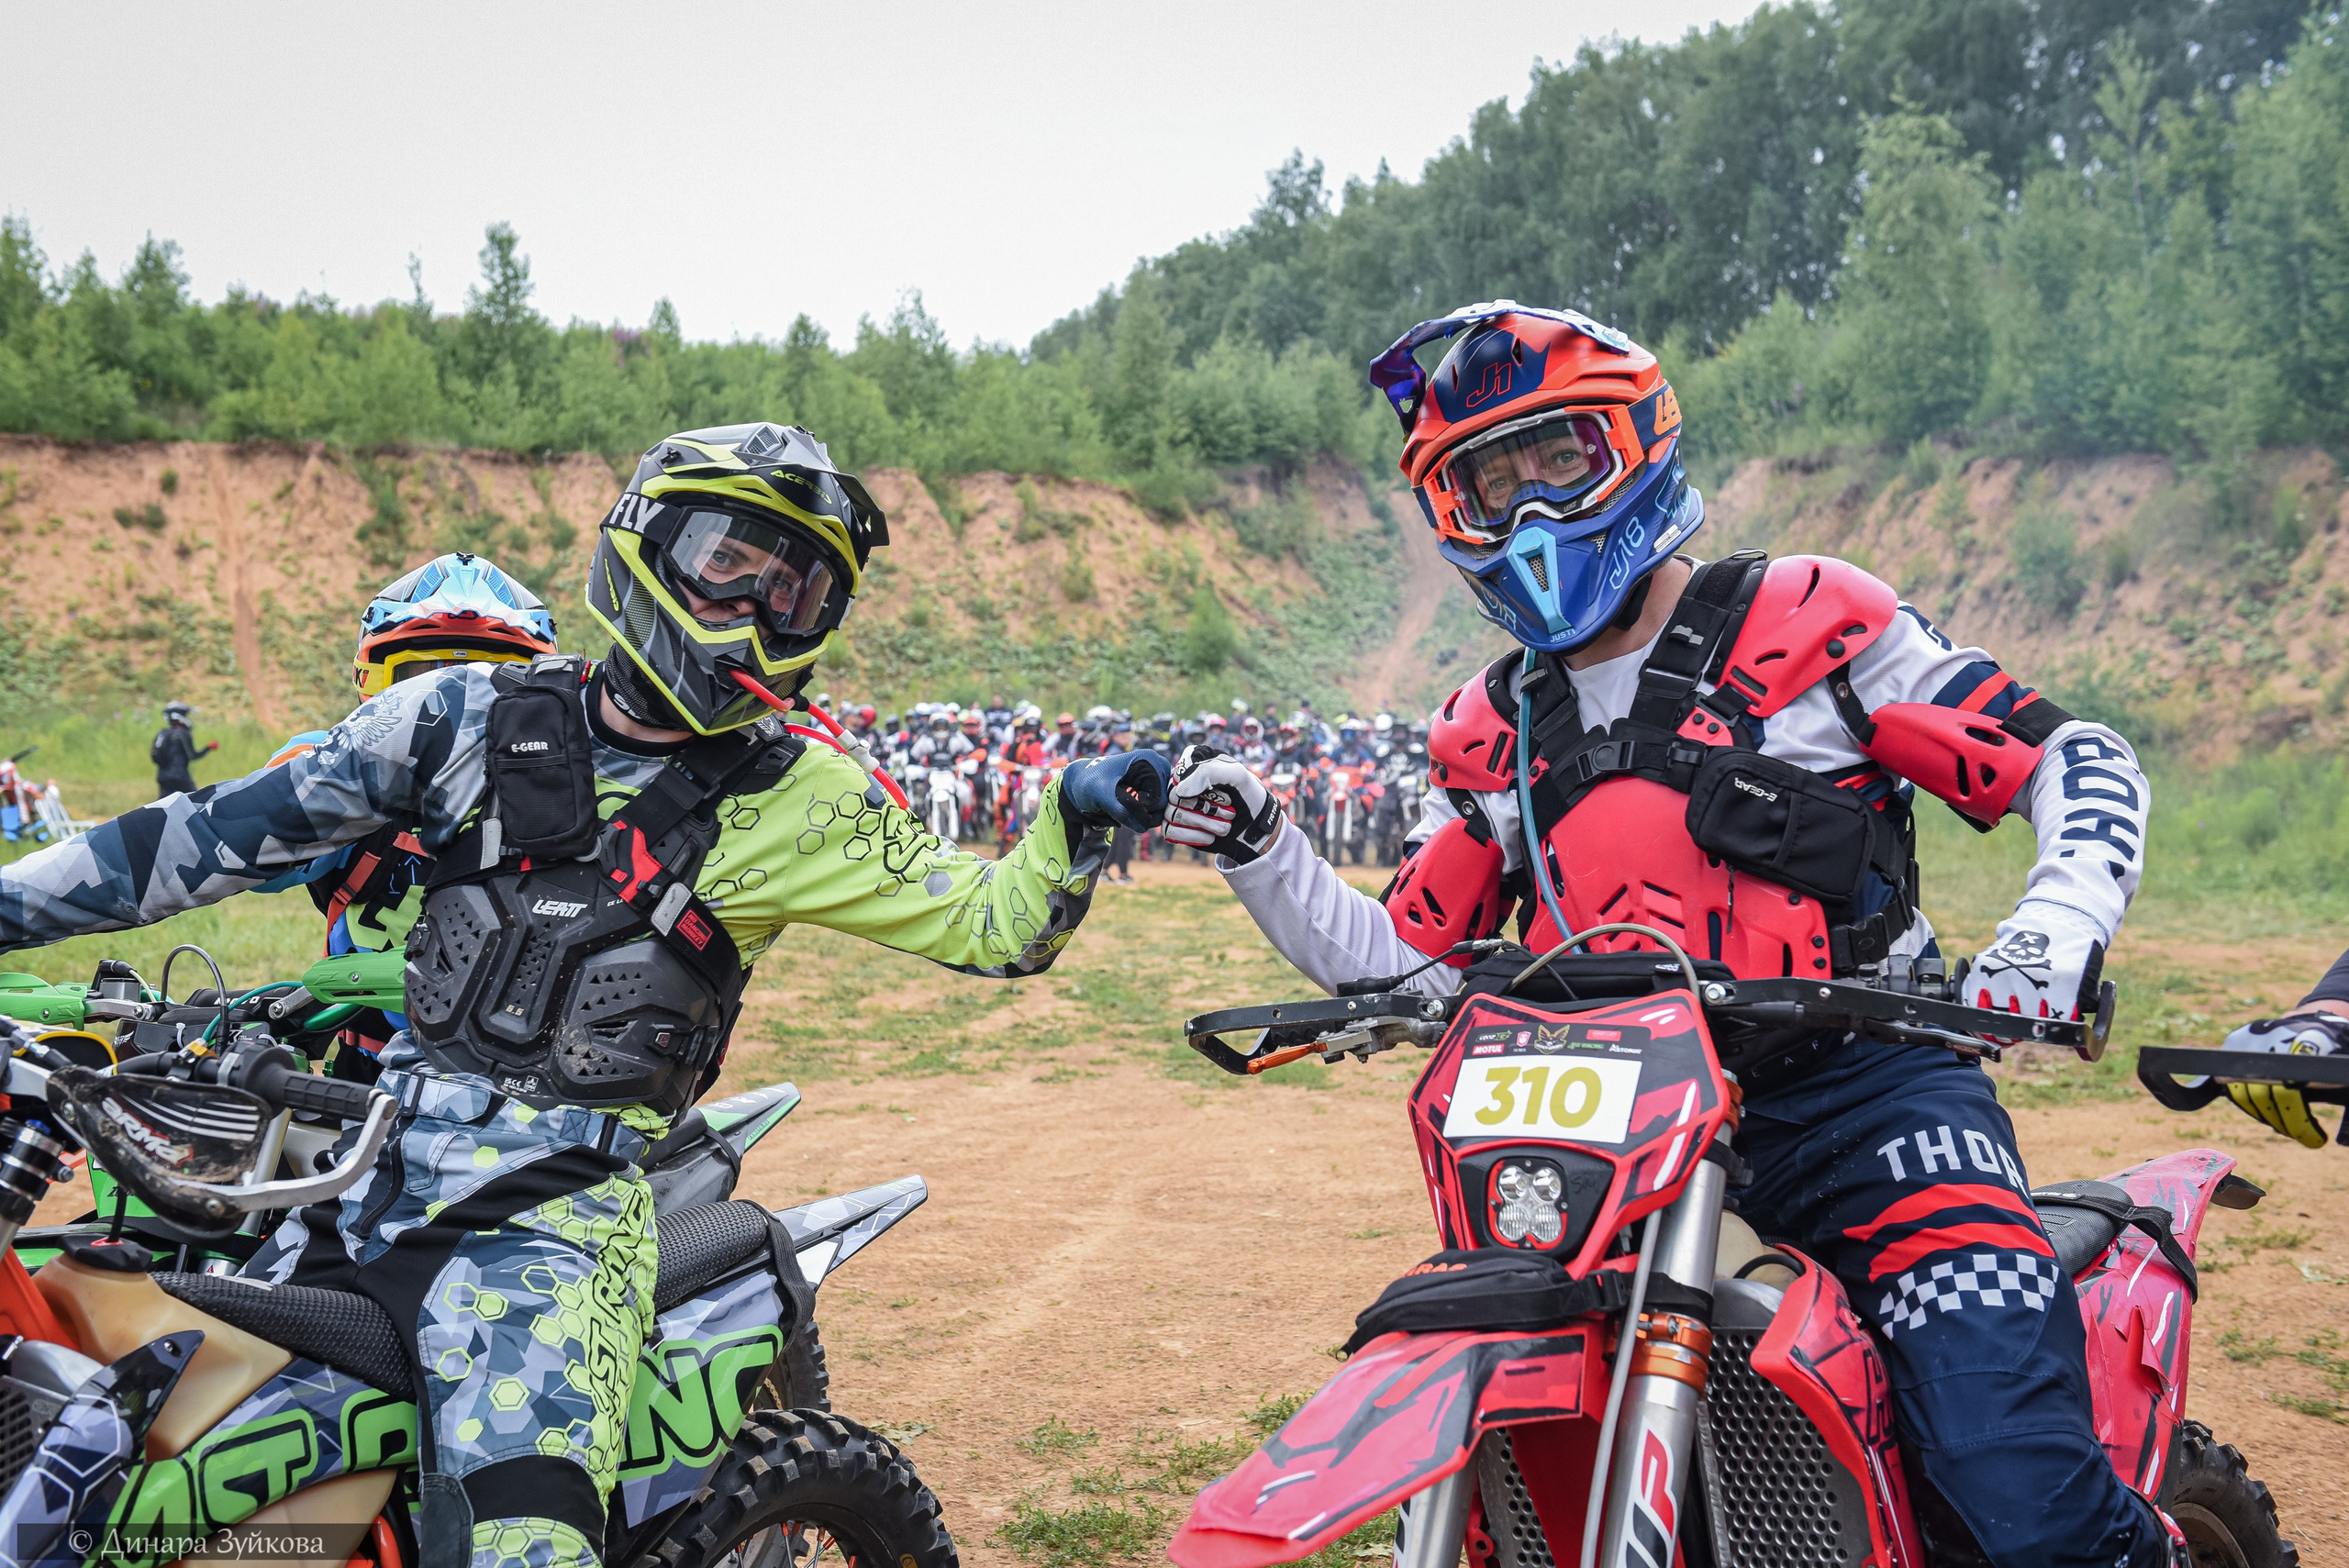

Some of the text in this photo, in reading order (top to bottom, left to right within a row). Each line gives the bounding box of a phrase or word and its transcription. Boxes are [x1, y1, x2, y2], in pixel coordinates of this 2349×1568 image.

[607, 493, 665, 534] FLY
[1550, 628, 1576, 643] JUST1
[510, 740, 550, 753] E-GEAR
[1734, 777, 1778, 802] E-GEAR
[531, 899, 589, 918] LEATT
[1474, 1046, 1502, 1054] MOTUL
[1475, 1066, 1602, 1129] 310
[1876, 1125, 2030, 1199] THOR
